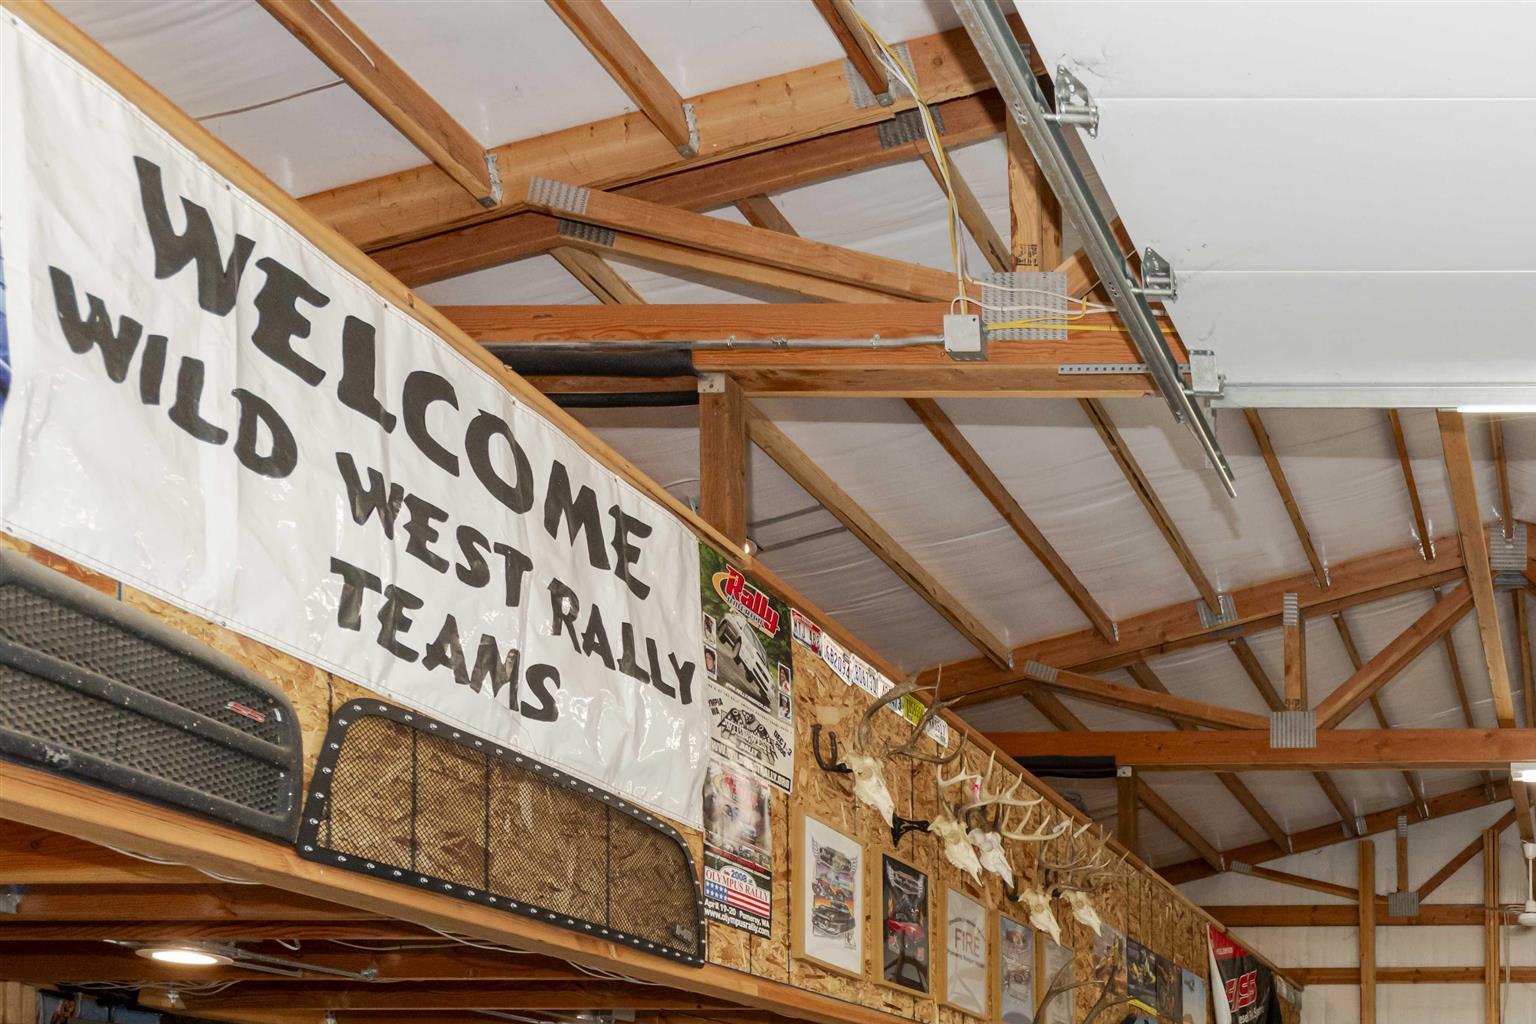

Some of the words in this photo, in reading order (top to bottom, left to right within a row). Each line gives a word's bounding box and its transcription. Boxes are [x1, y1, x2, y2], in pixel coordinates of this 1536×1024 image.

[134, 156, 652, 599] WELCOME
[50, 265, 298, 479] WILD
[336, 452, 533, 607] WEST
[548, 578, 696, 705] RALLY
[726, 564, 779, 634] Rally
[330, 556, 561, 722] TEAMS
[704, 898, 719, 909] April
[705, 869, 744, 892] OLYMPUS
[746, 884, 768, 901] RALLY
[955, 928, 980, 957] FIRE
